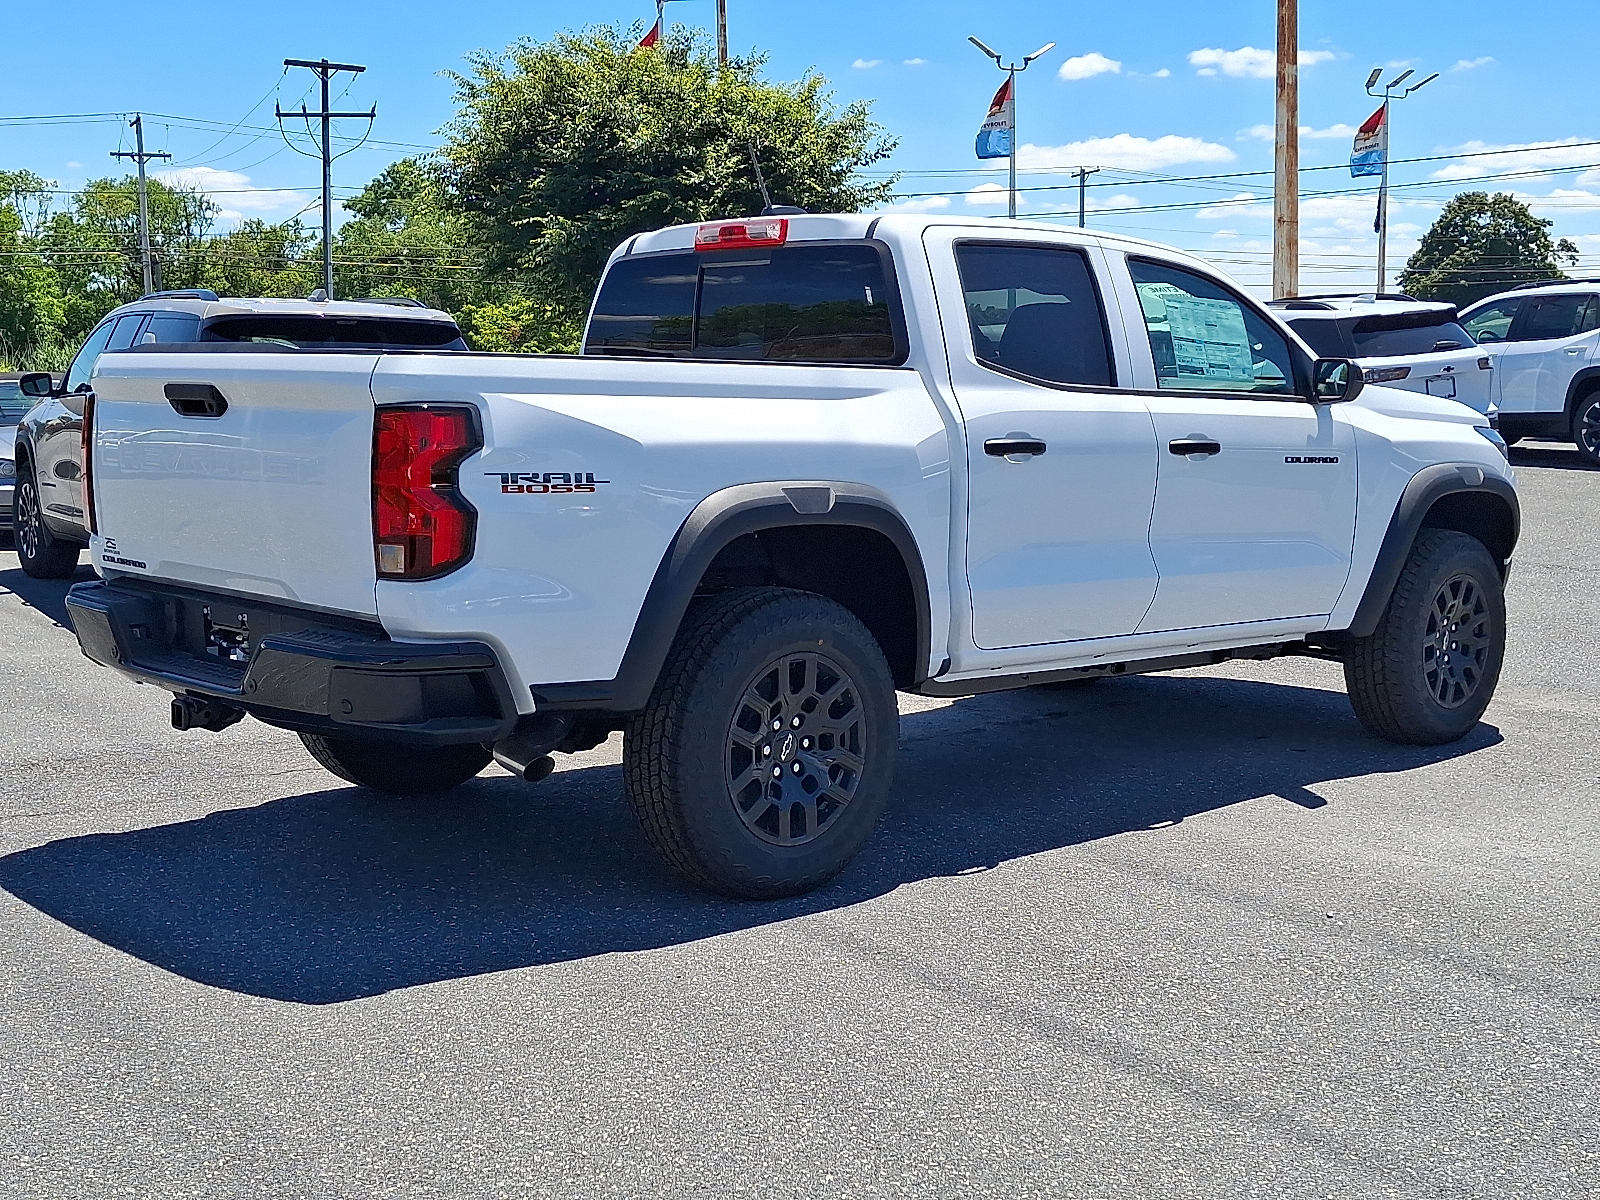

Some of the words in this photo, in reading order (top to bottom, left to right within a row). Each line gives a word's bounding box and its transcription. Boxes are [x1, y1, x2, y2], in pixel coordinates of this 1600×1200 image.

[982, 121, 1007, 129] EVROLET
[102, 442, 321, 482] CHEVROLET
[1284, 456, 1339, 464] COLORADO
[484, 472, 611, 485] TRAIL
[501, 484, 596, 494] BOSS
[102, 554, 147, 569] COLORADO
